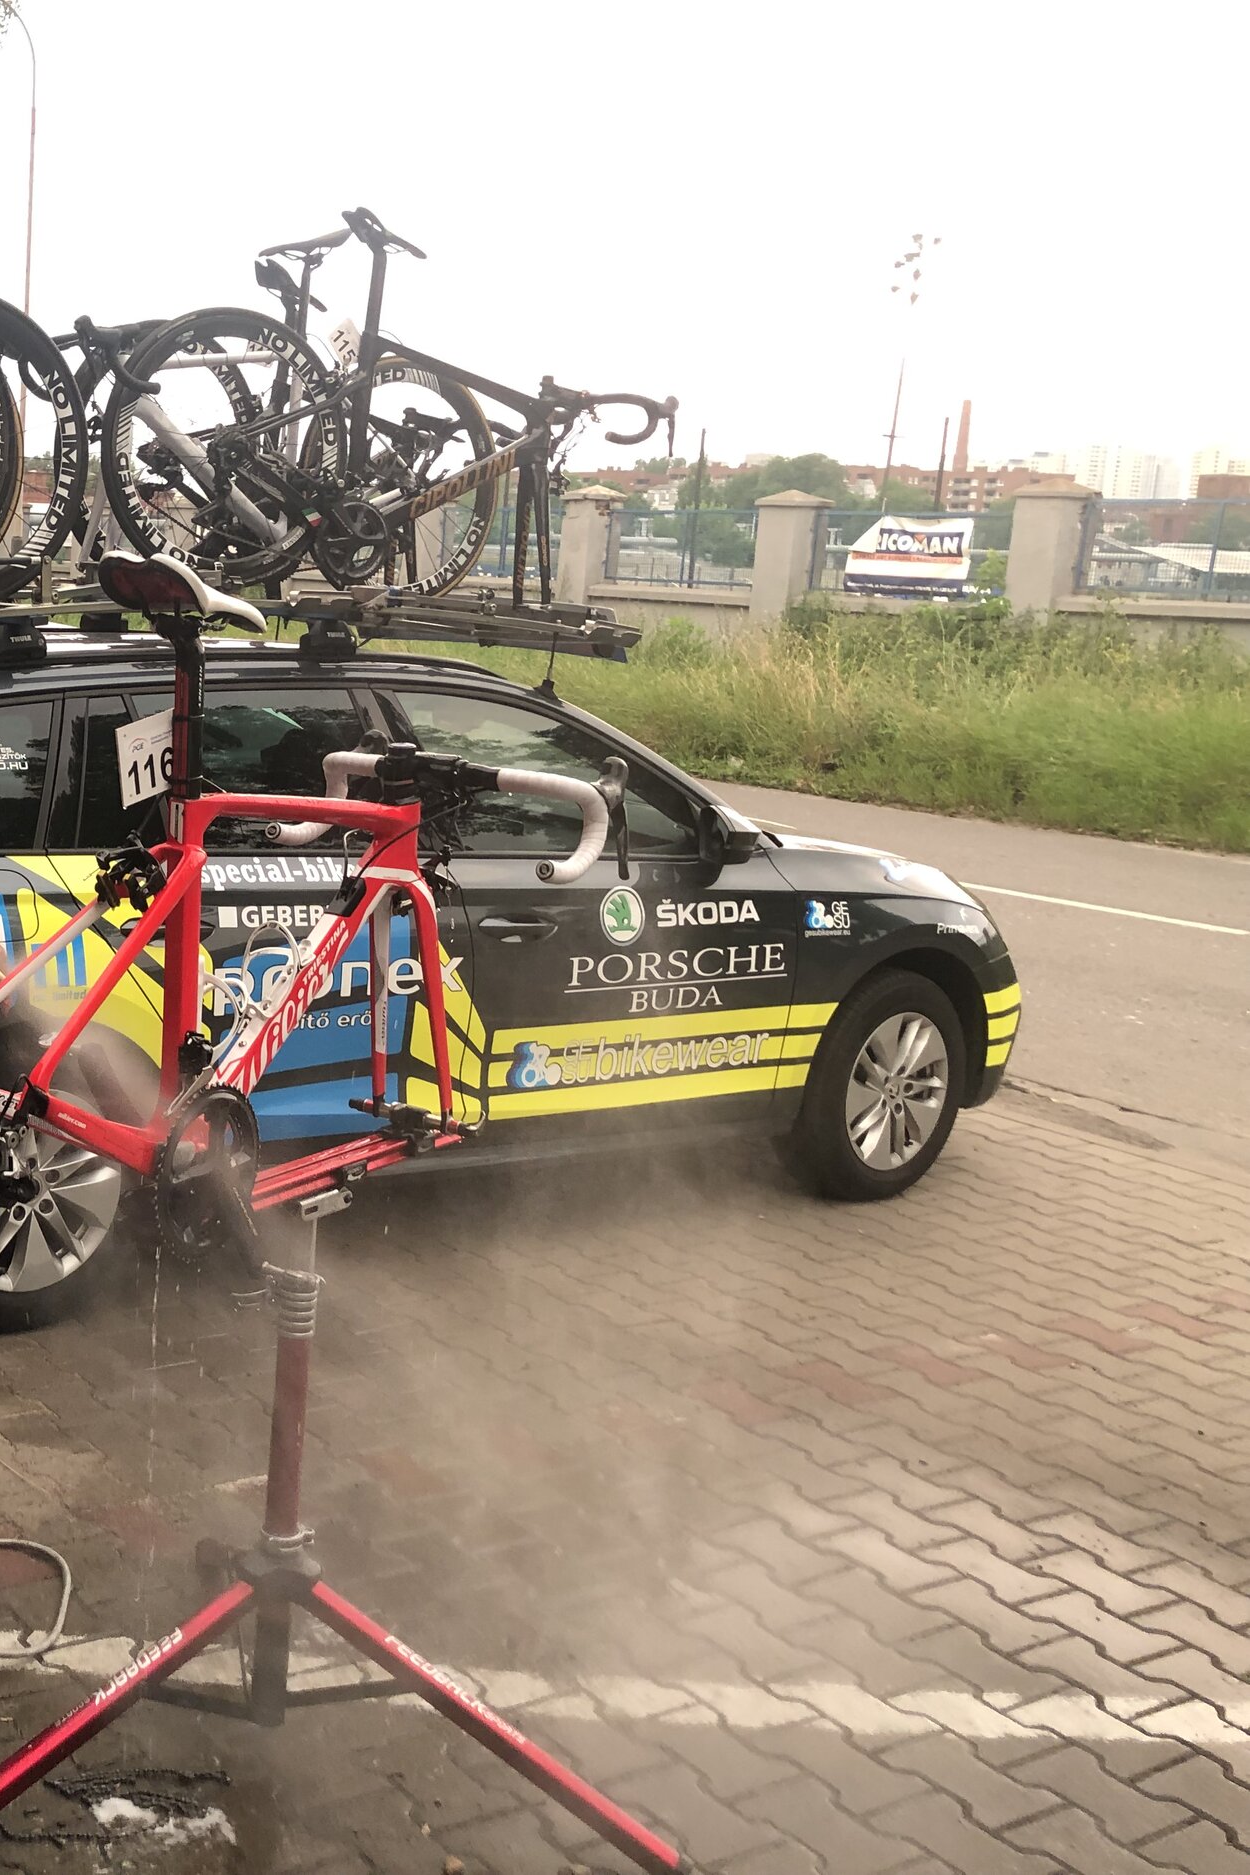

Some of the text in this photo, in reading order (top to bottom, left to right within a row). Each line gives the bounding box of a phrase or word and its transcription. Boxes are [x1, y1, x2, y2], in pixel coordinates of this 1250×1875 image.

[128, 747, 174, 795] 116
[241, 905, 330, 928] GEBER
[656, 899, 760, 928] ŠKODA
[302, 919, 346, 985] TRIESTINA
[567, 943, 786, 987] PORSCHE
[629, 985, 723, 1013] BUDA
[595, 1032, 769, 1081] bikewear
[94, 1627, 183, 1707] FEEDBACK
[384, 1635, 486, 1714] FEEDBACK
